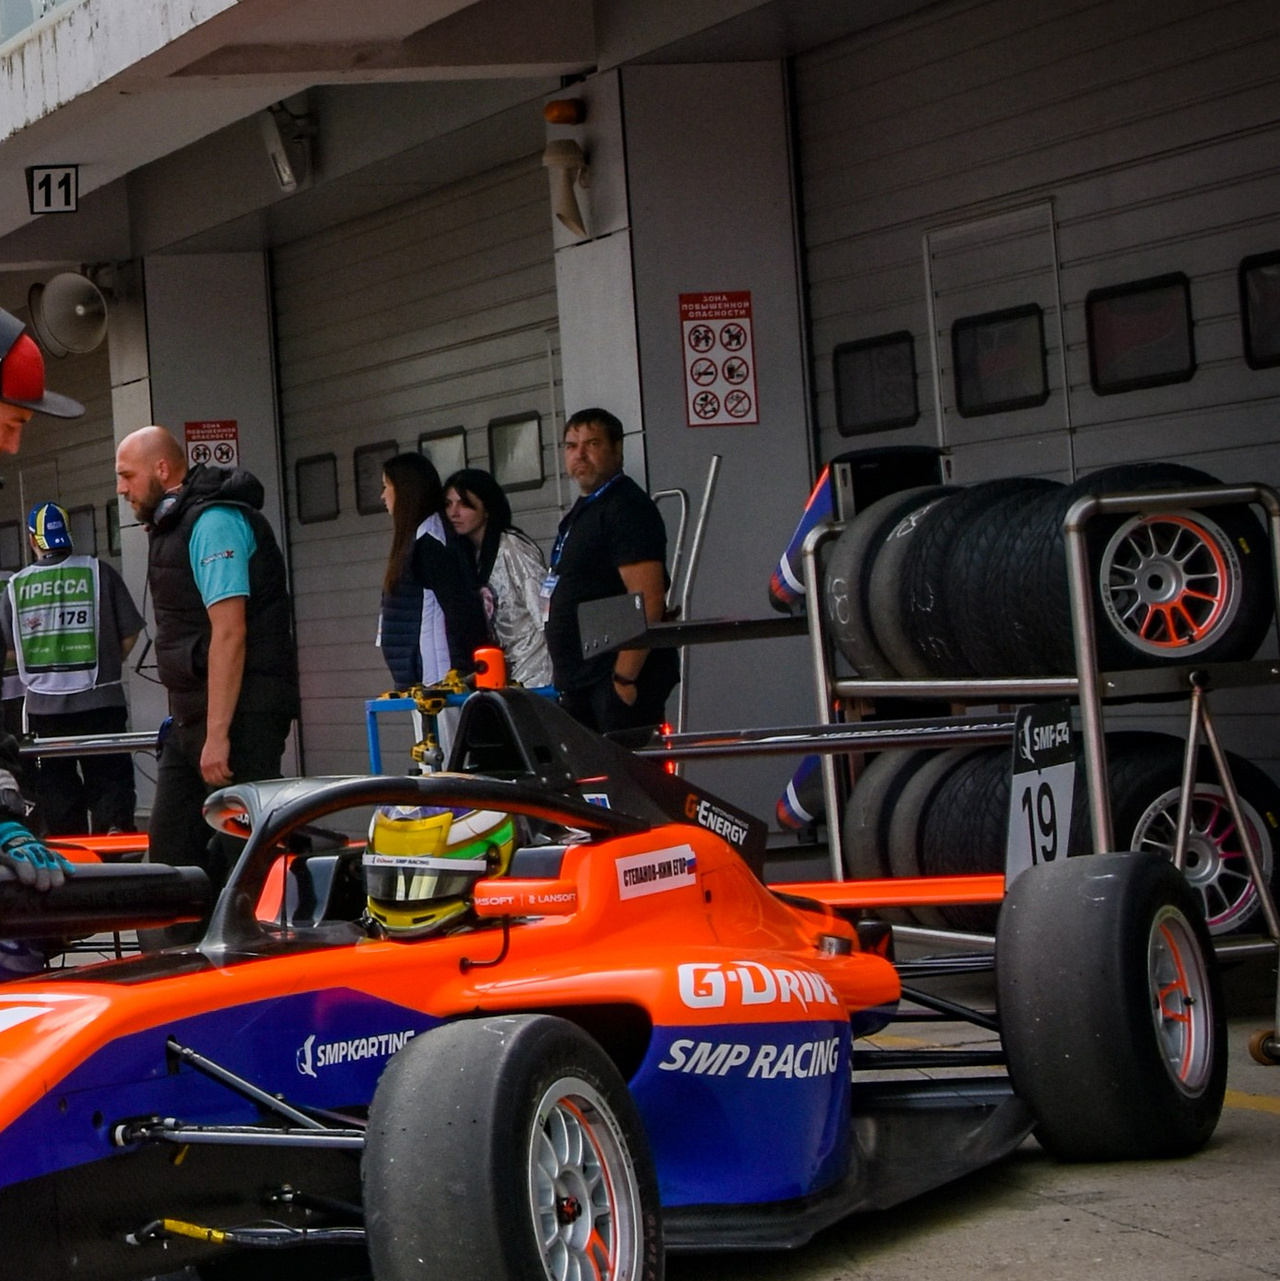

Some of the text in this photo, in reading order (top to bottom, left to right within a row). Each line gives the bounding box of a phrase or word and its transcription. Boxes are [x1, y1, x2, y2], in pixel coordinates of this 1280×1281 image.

[38, 173, 72, 207] 11
[681, 302, 750, 310] ПОВЫШЕННОЙ
[688, 309, 746, 318] ОПАСНОСТИ
[20, 579, 89, 601] ПРЕССА
[58, 610, 88, 625] 178
[1022, 782, 1058, 866] 19
[673, 858, 687, 876] ЕГОР
[538, 893, 577, 903] LANSOFT
[658, 1037, 840, 1079] SMP RACING
